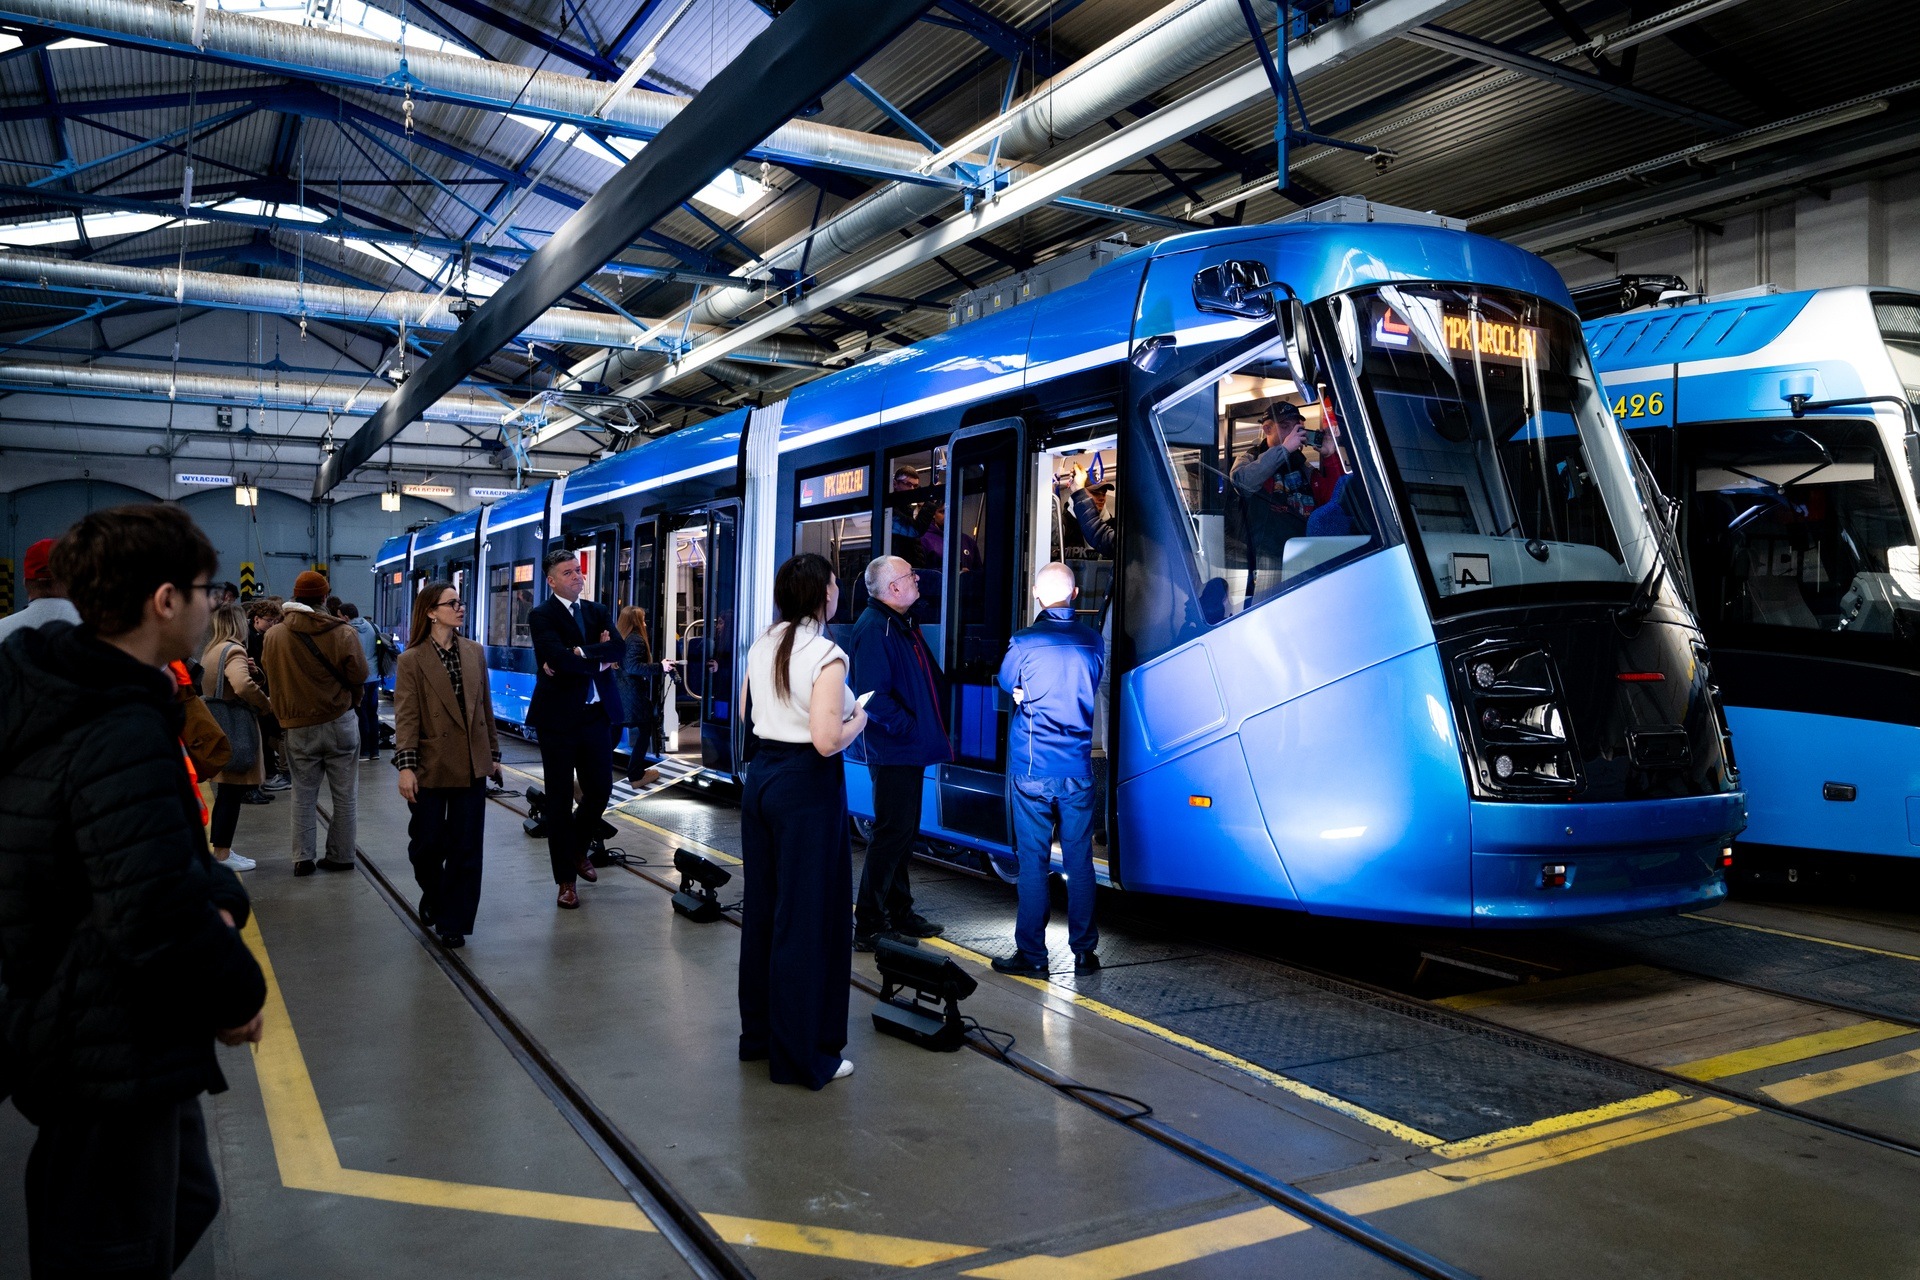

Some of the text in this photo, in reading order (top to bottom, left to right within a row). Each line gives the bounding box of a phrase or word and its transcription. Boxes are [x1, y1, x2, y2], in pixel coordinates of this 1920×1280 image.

[1443, 315, 1471, 350] MPK
[1609, 391, 1664, 419] 426
[84, 469, 90, 478] 3
[242, 472, 248, 485] 4
[391, 481, 397, 493] 5
[1461, 568, 1480, 588] A
